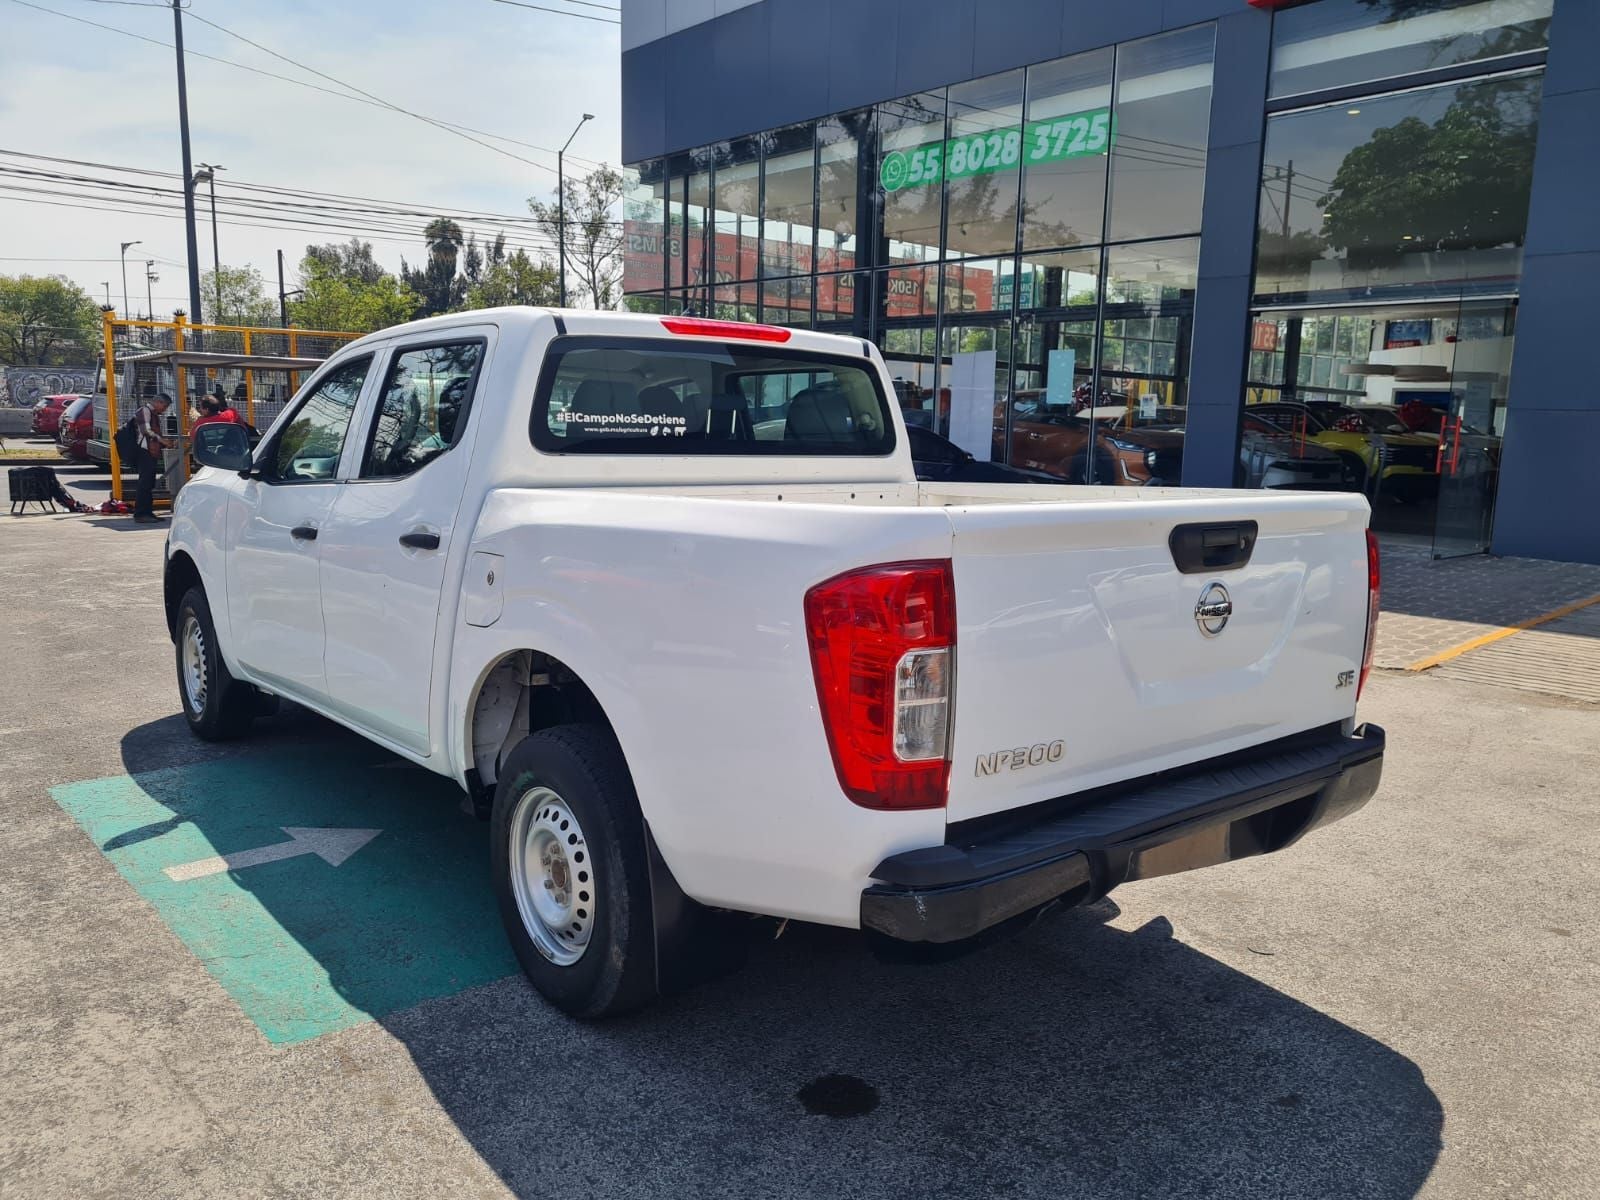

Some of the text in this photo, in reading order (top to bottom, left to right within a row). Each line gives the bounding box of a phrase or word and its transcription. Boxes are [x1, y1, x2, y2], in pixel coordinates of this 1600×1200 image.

[910, 112, 1110, 182] 55 8028 3725
[556, 412, 686, 426] #ElCampoNoSeDetiene
[974, 739, 1065, 778] NP300
